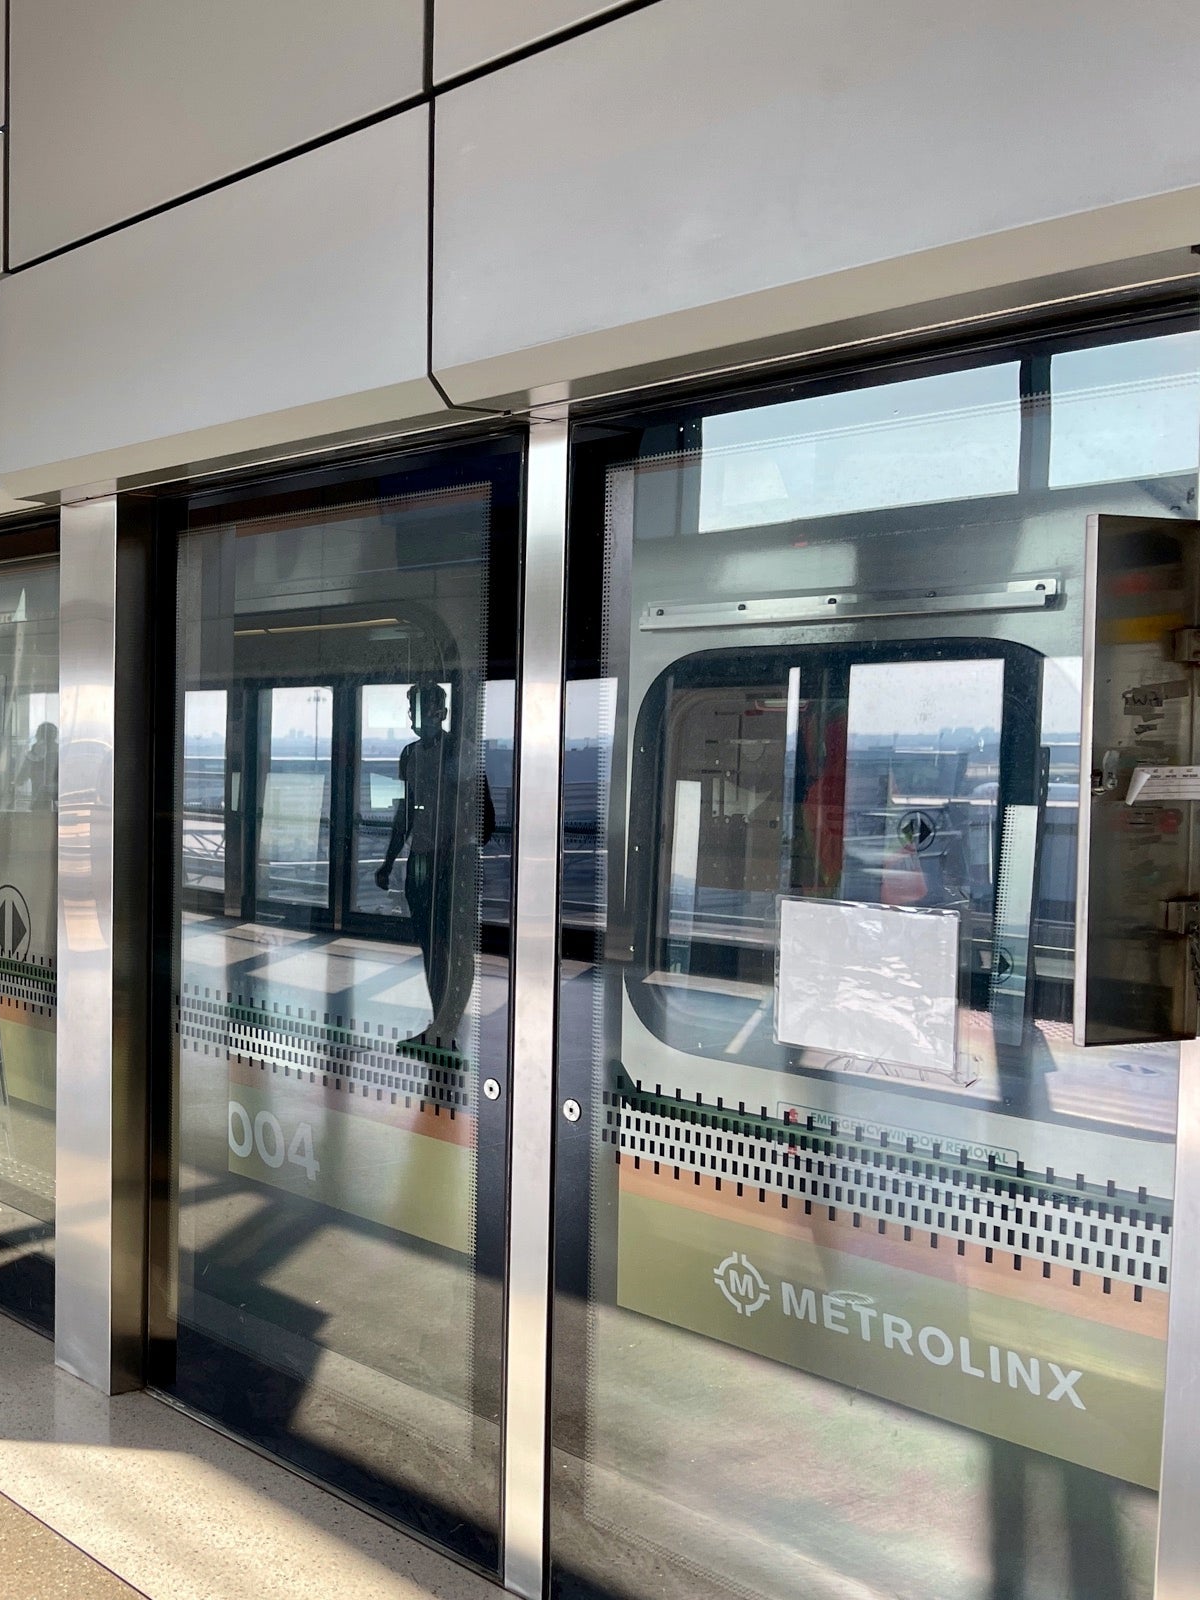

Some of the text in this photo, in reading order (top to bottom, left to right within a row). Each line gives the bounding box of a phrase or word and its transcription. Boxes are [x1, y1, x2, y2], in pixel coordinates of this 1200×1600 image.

[228, 1100, 321, 1182] 004
[810, 1112, 1009, 1164] EMERGENCY WINDOW REMOVAL
[780, 1281, 1088, 1411] METROLINX
